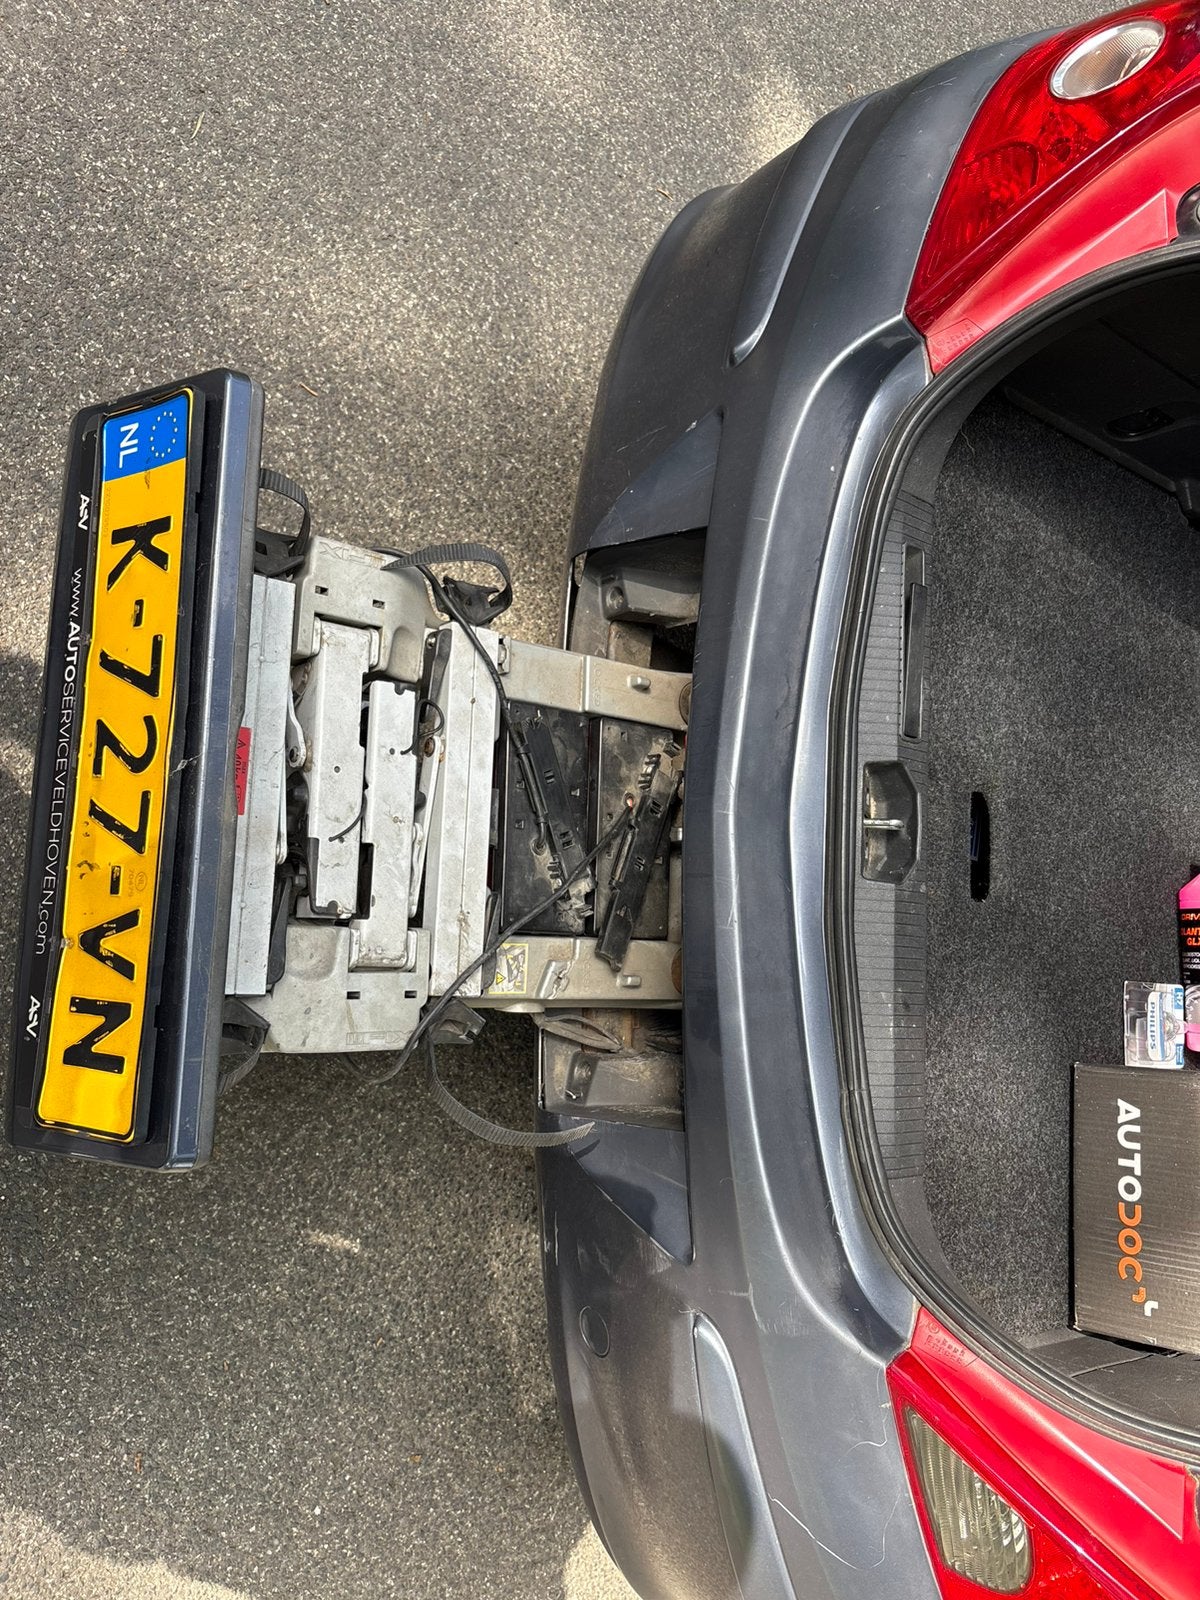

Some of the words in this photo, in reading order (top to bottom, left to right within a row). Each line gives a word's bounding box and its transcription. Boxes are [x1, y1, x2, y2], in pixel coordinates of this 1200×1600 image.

[118, 422, 139, 469] NL
[77, 491, 89, 531] ASV
[35, 567, 83, 956] www.AUTOSERVICEVELDHOVEN.com
[62, 515, 173, 1075] K-727-VN
[26, 994, 41, 1038] ASV
[1176, 992, 1184, 1005] H7
[1116, 1098, 1143, 1283] AUTODOC
